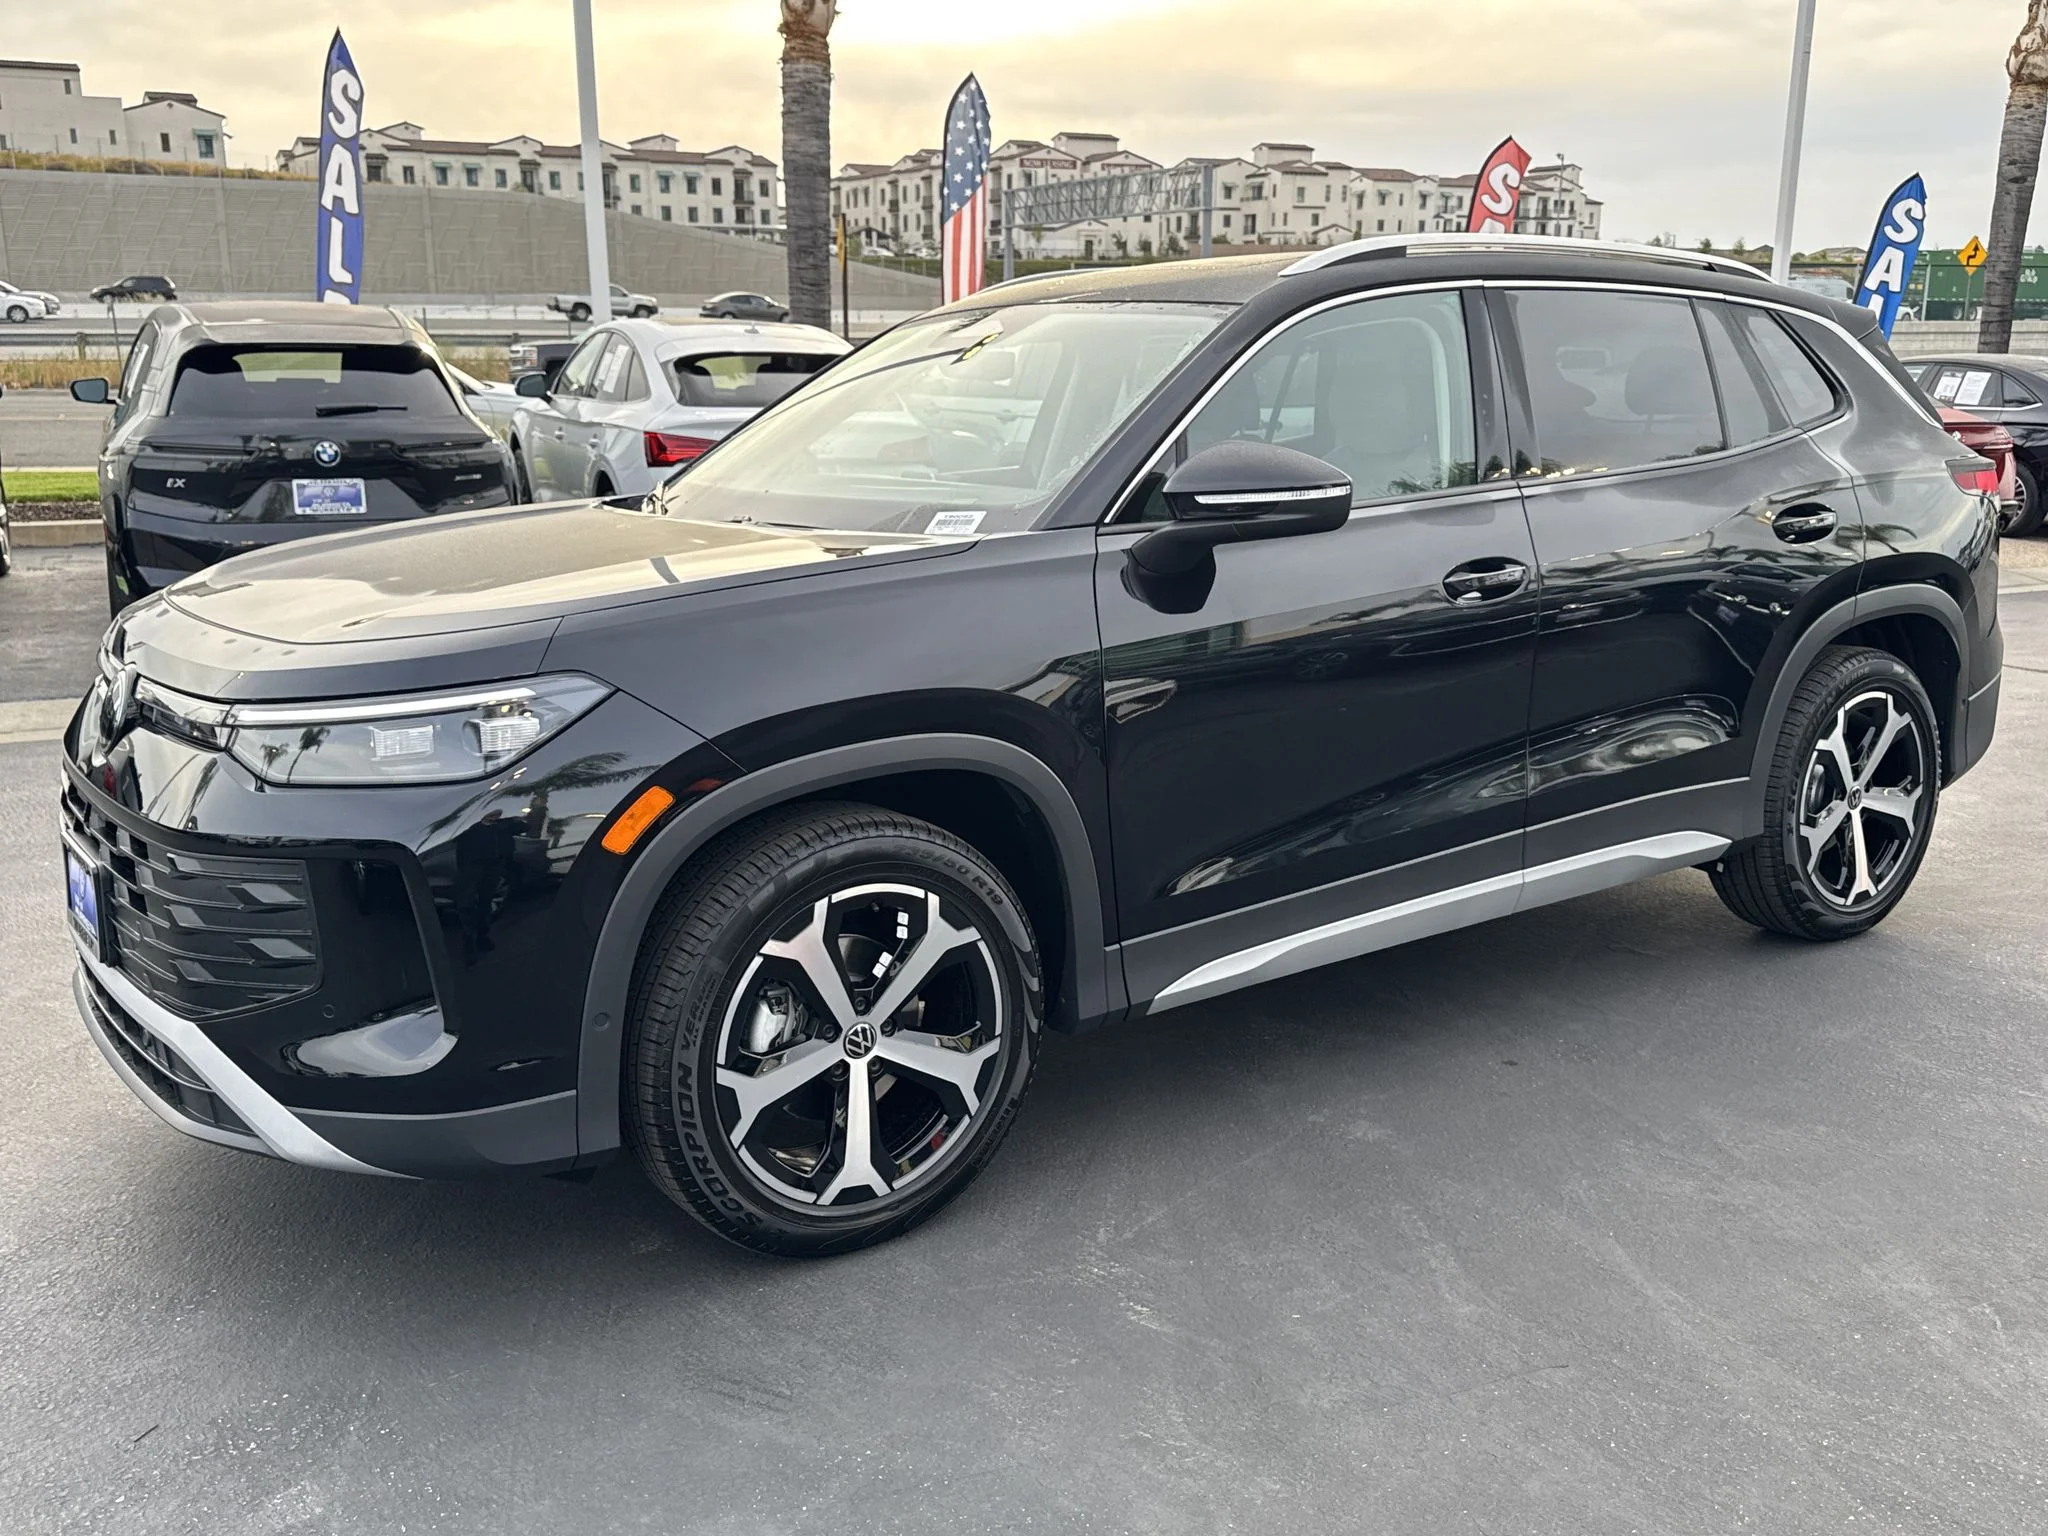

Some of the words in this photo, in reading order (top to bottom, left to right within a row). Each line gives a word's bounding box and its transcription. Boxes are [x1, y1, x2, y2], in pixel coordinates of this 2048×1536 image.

[321, 68, 361, 304] SAL
[971, 875, 1005, 907] R19
[676, 1061, 764, 1228] SCORPION
